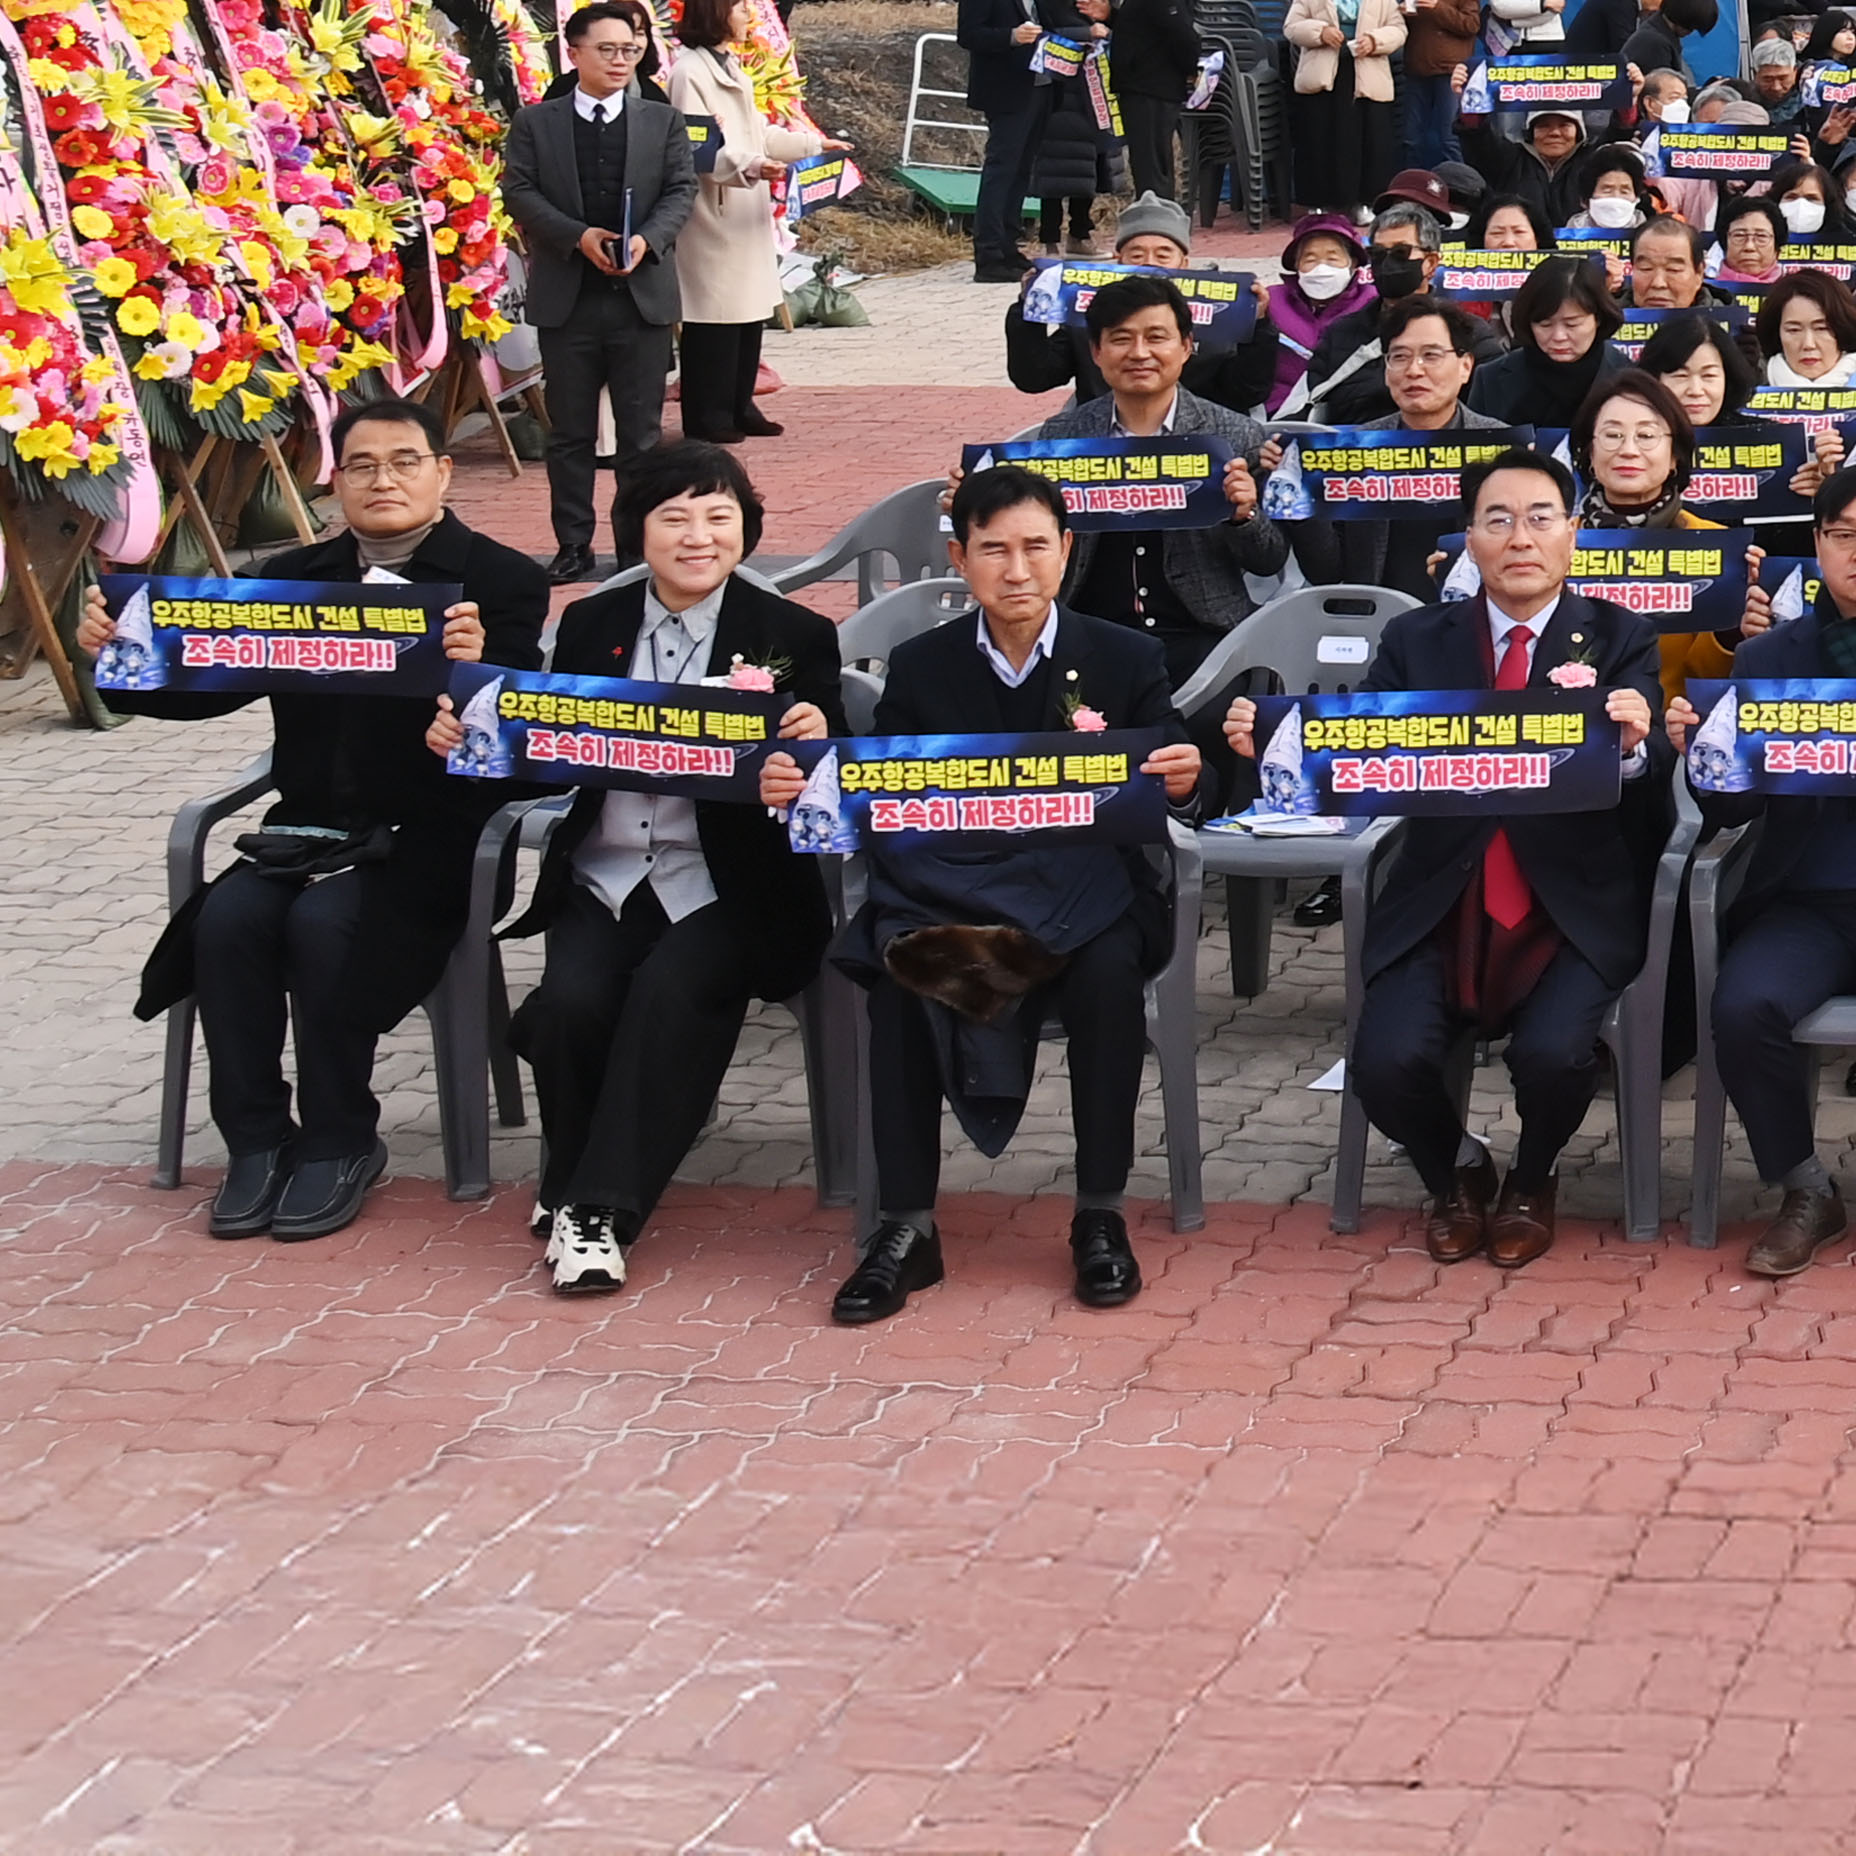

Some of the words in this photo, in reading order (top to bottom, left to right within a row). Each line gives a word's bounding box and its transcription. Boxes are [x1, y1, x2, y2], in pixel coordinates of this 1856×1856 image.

[1502, 85, 1539, 101] 조속히
[1541, 84, 1600, 100] 제정하라!!
[1673, 152, 1710, 168] 조속히
[1711, 153, 1770, 169] 제정하라!!
[1127, 456, 1158, 480] 건설
[1160, 454, 1210, 478] 특별법
[1302, 447, 1427, 472] 우주항공복합도시
[1431, 447, 1462, 469] 건설
[1701, 446, 1732, 469] 건설
[1735, 443, 1783, 468] 특별법
[1087, 484, 1188, 514] 제정하라!!
[1326, 477, 1387, 500] 조속히
[153, 600, 315, 630] 우주항공복합도시
[317, 605, 361, 632] 건설
[363, 606, 427, 634] 특별법
[185, 635, 264, 666] 조속히
[270, 638, 394, 670] 제정하라!!
[500, 691, 656, 733] 우주항공복합도시
[660, 707, 700, 738] 건설
[705, 711, 767, 741] 특별법
[1305, 716, 1470, 751] 우주항공복합도시
[1476, 715, 1517, 747] 건설
[1523, 713, 1584, 745] 특별법
[529, 730, 605, 765] 조속히
[610, 739, 733, 775] 제정하라!!
[1767, 742, 1846, 772] 조속히
[840, 758, 1011, 793] 우주항공복합도시
[1015, 756, 1059, 788] 건설
[1063, 753, 1128, 784] 특별법
[1334, 757, 1416, 791] 조속히
[1422, 755, 1548, 789] 제정하라!!
[873, 798, 956, 830] 조속히
[961, 794, 1093, 829] 제정하라!!
